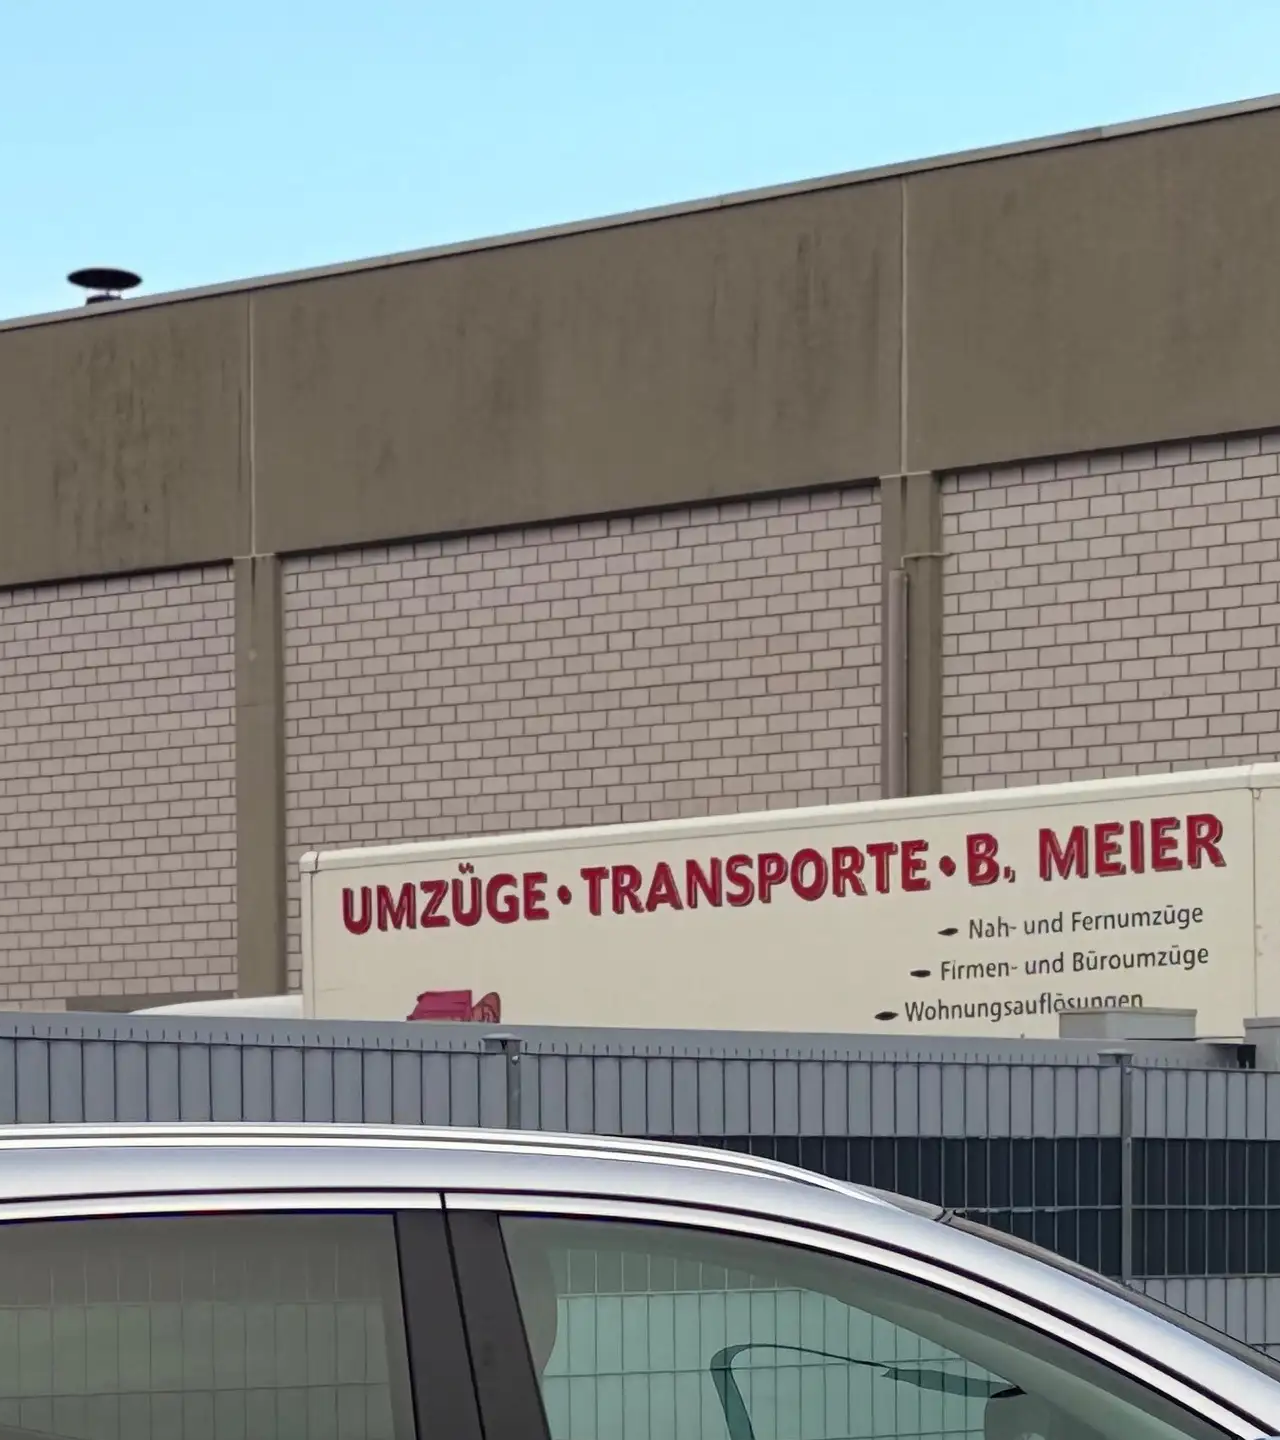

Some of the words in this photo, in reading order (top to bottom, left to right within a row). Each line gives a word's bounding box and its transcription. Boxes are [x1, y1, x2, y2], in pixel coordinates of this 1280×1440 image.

[342, 862, 550, 935] UMZÜGE
[579, 838, 931, 917] TRANSPORTE
[966, 832, 1016, 887] B.
[1038, 813, 1227, 882] MEIER
[968, 915, 1017, 940] Nah-
[1023, 911, 1063, 936] und
[1071, 904, 1204, 932] Fernumzüge
[940, 959, 1018, 981] Firmen-
[1024, 951, 1064, 976] und
[1072, 944, 1209, 973] Büroumzüge
